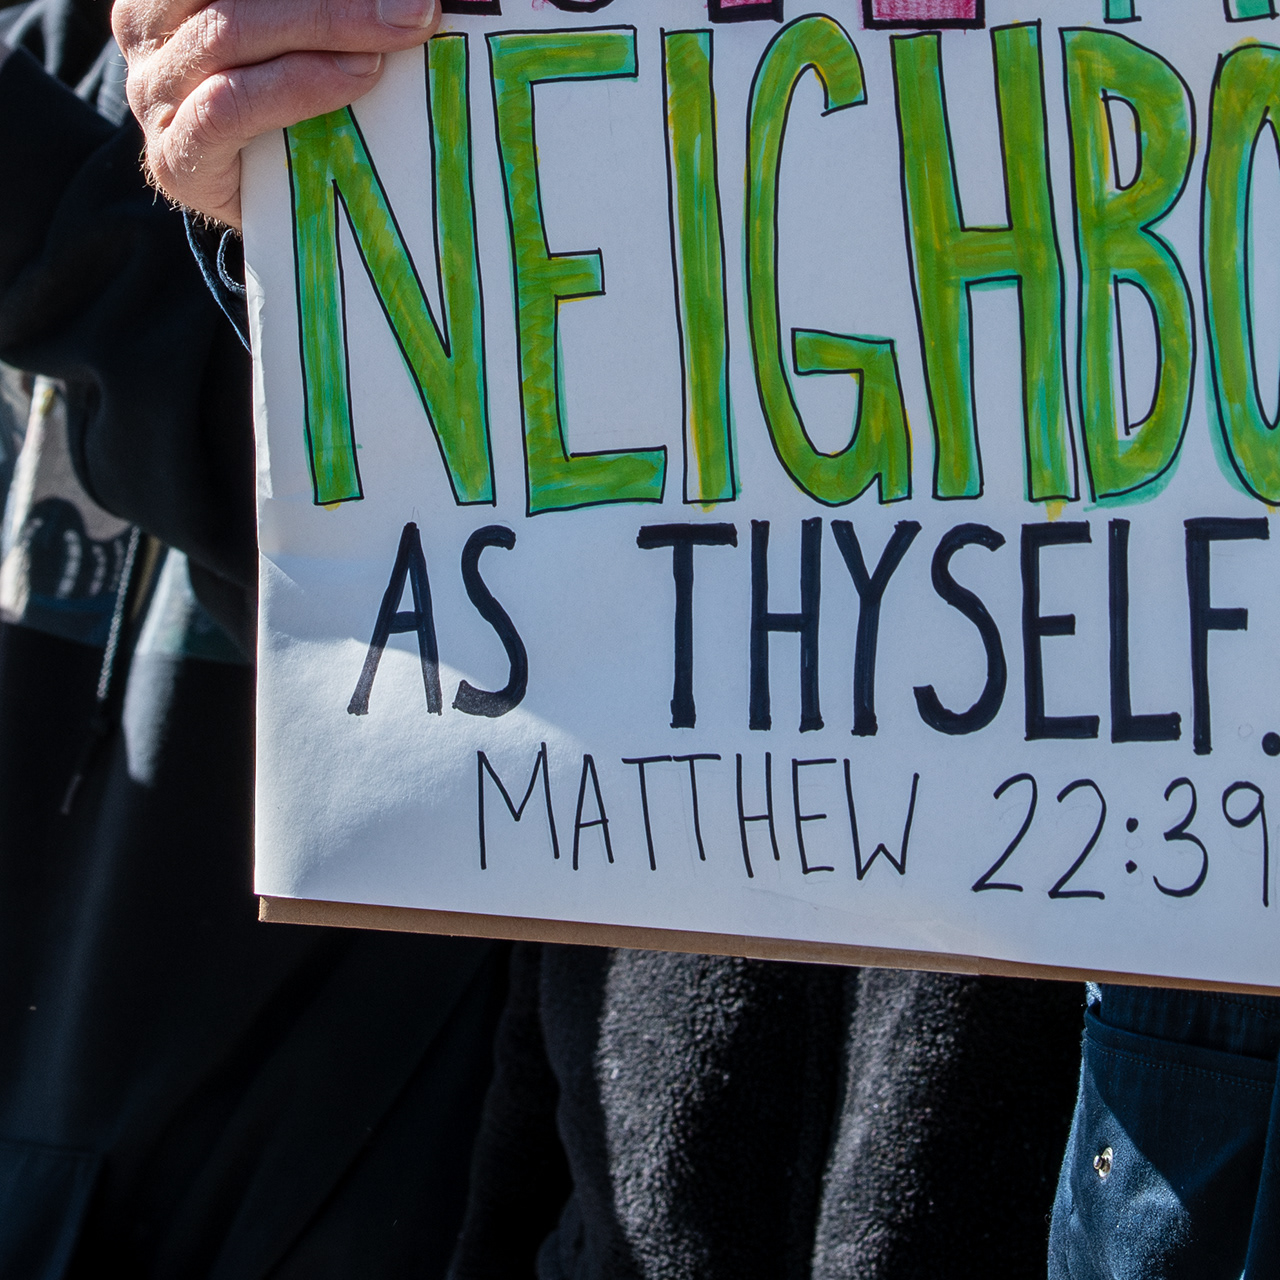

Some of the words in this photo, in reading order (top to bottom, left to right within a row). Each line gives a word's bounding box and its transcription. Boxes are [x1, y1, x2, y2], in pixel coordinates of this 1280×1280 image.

[348, 522, 528, 716] AS
[477, 742, 919, 880] MATTHEW
[972, 774, 1272, 906] 22:39
